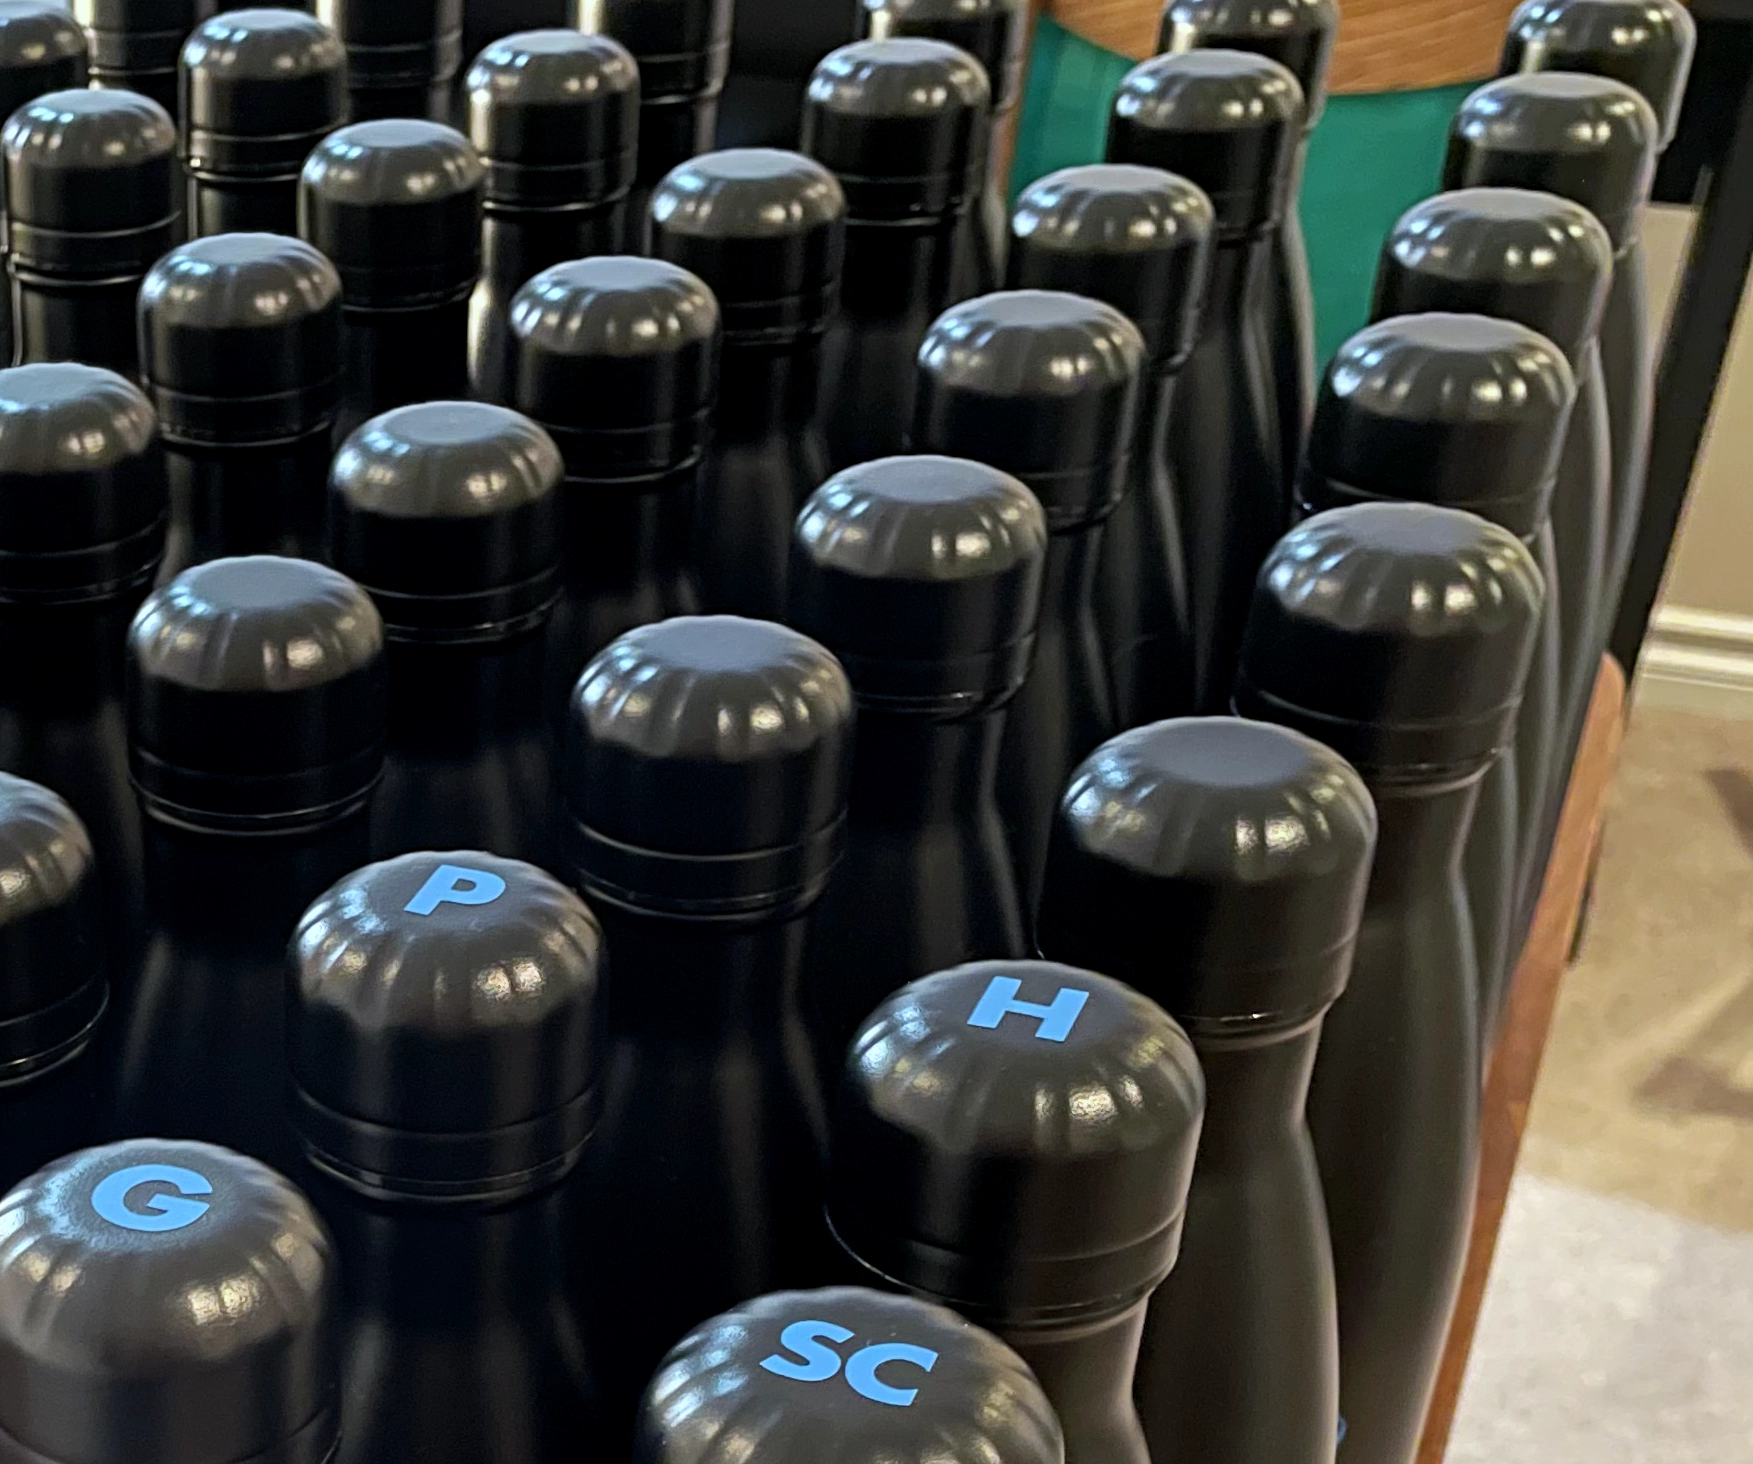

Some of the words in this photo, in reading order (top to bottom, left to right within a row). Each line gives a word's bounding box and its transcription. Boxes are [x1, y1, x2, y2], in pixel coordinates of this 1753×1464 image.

[402, 863, 507, 916] P
[965, 975, 1090, 1043] H
[89, 1163, 213, 1233] G
[759, 1318, 940, 1406] SC
